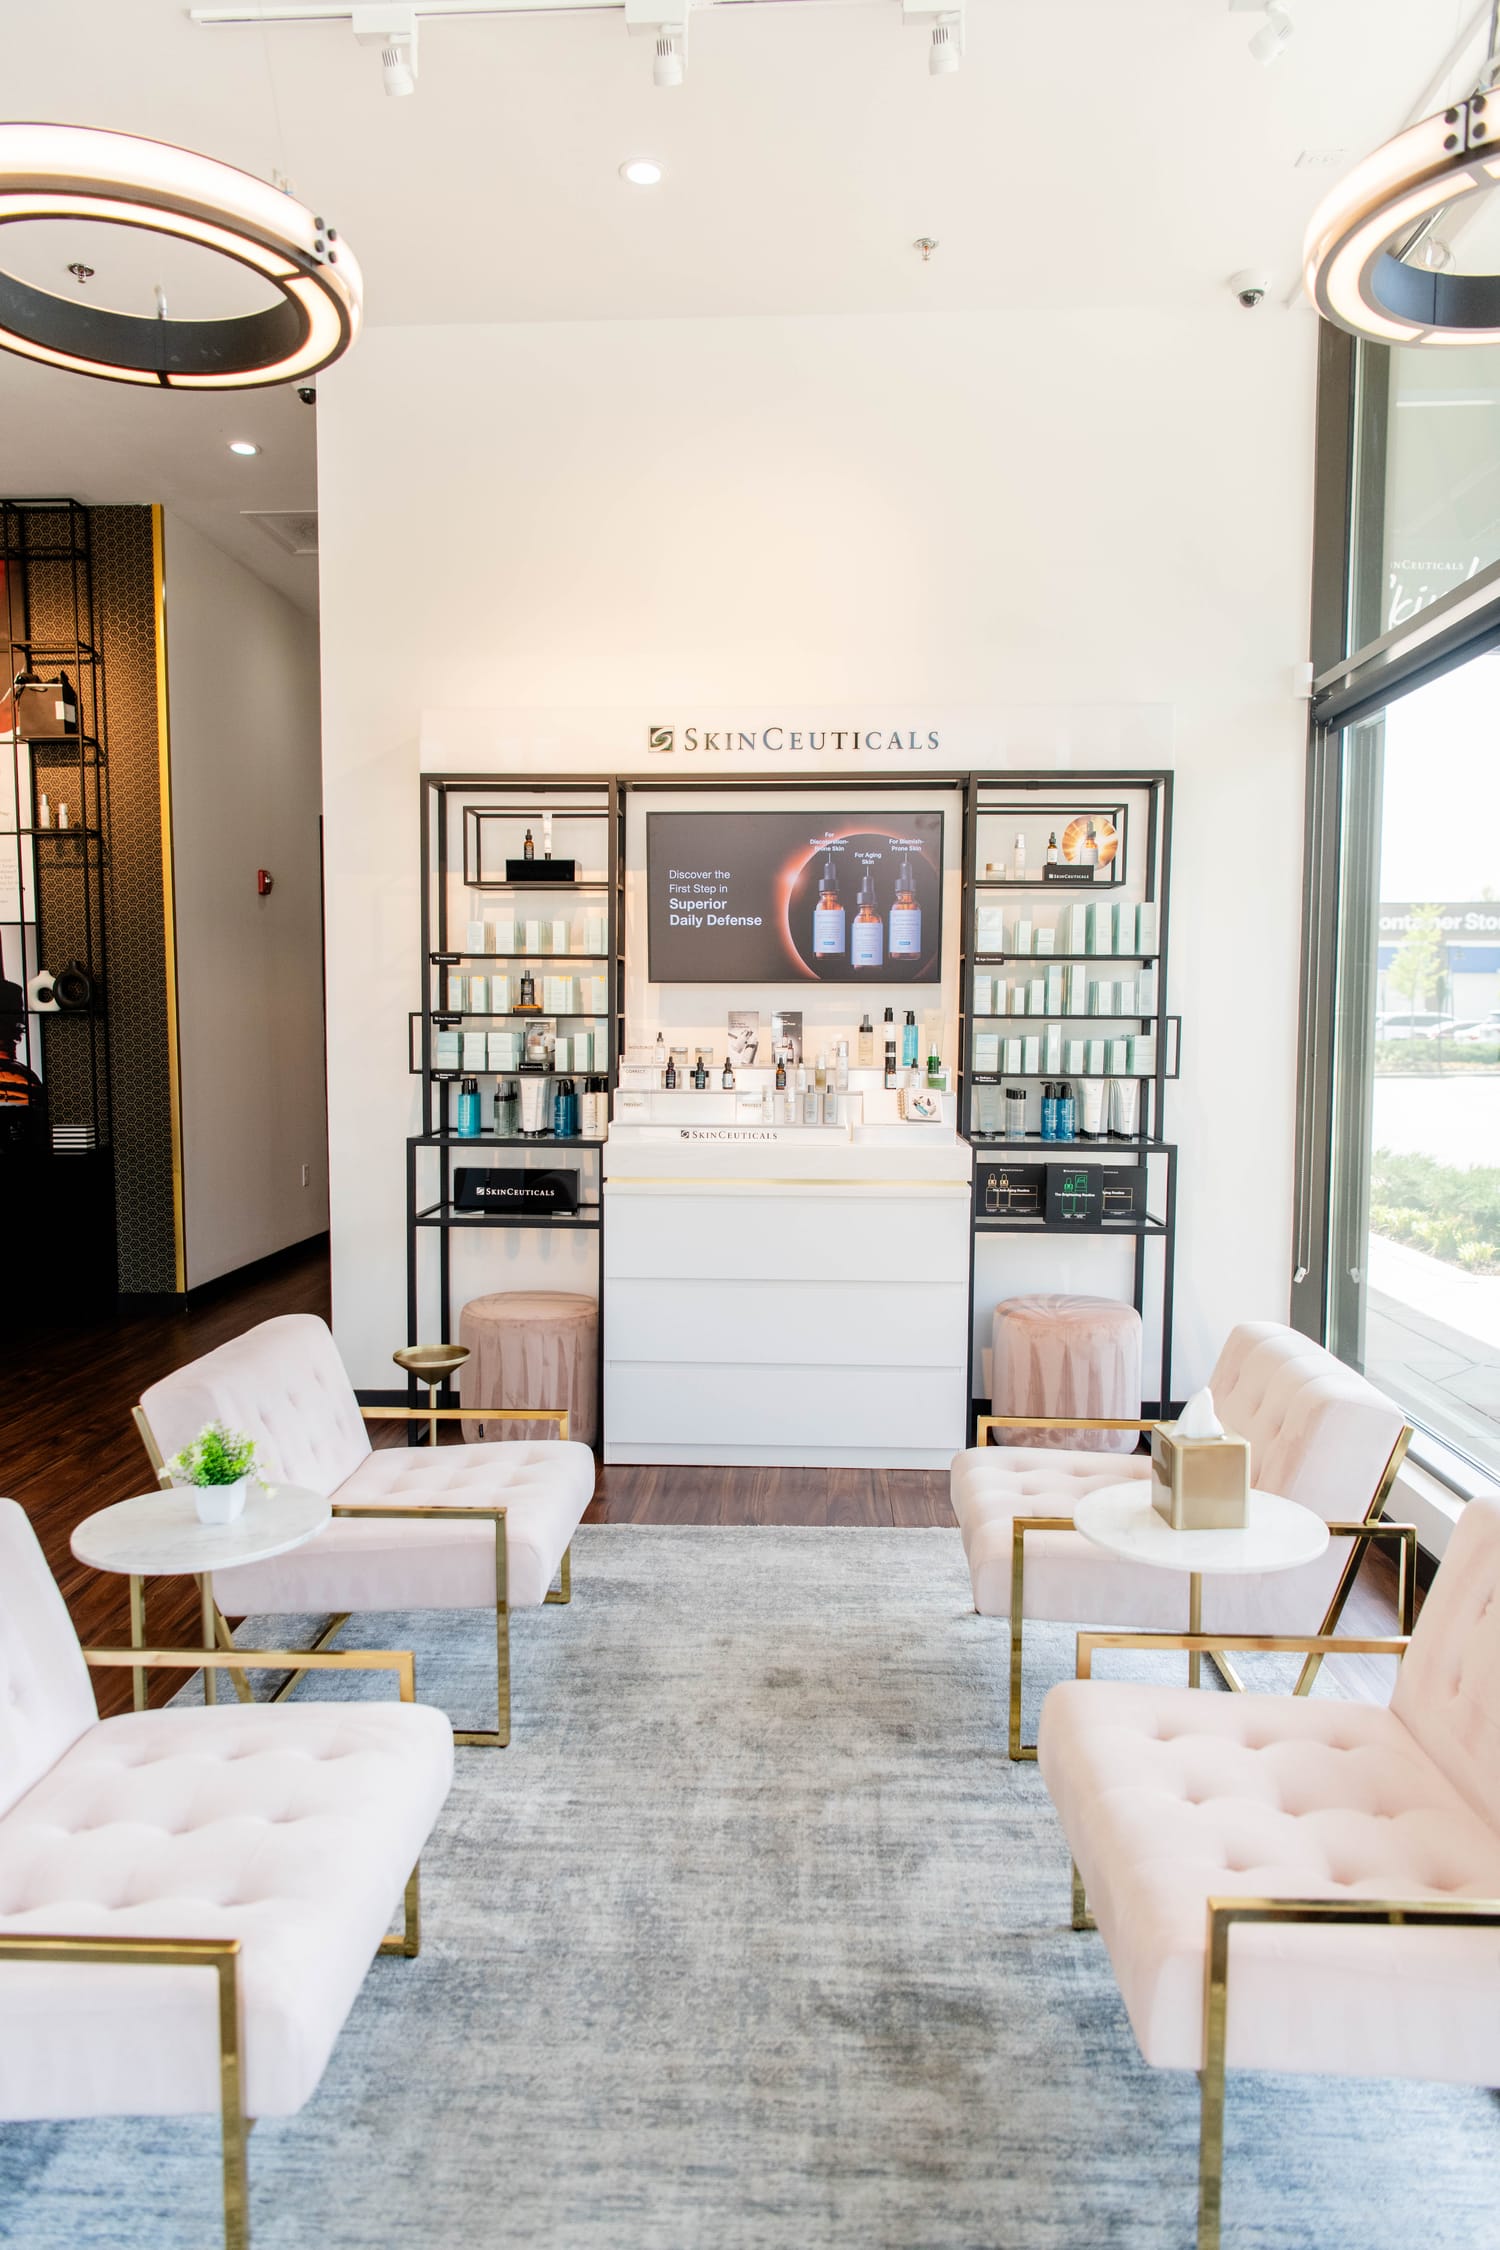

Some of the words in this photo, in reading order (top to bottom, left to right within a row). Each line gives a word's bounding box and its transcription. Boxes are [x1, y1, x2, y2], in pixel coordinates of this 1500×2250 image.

[669, 869, 712, 879] Discover
[714, 869, 731, 879] the
[669, 883, 691, 893] First
[693, 883, 717, 894] Step
[719, 883, 728, 893] in
[669, 897, 728, 911] Superior
[669, 914, 703, 928] Daily
[707, 914, 763, 926] Defense
[1465, 912, 1500, 930] Sto
